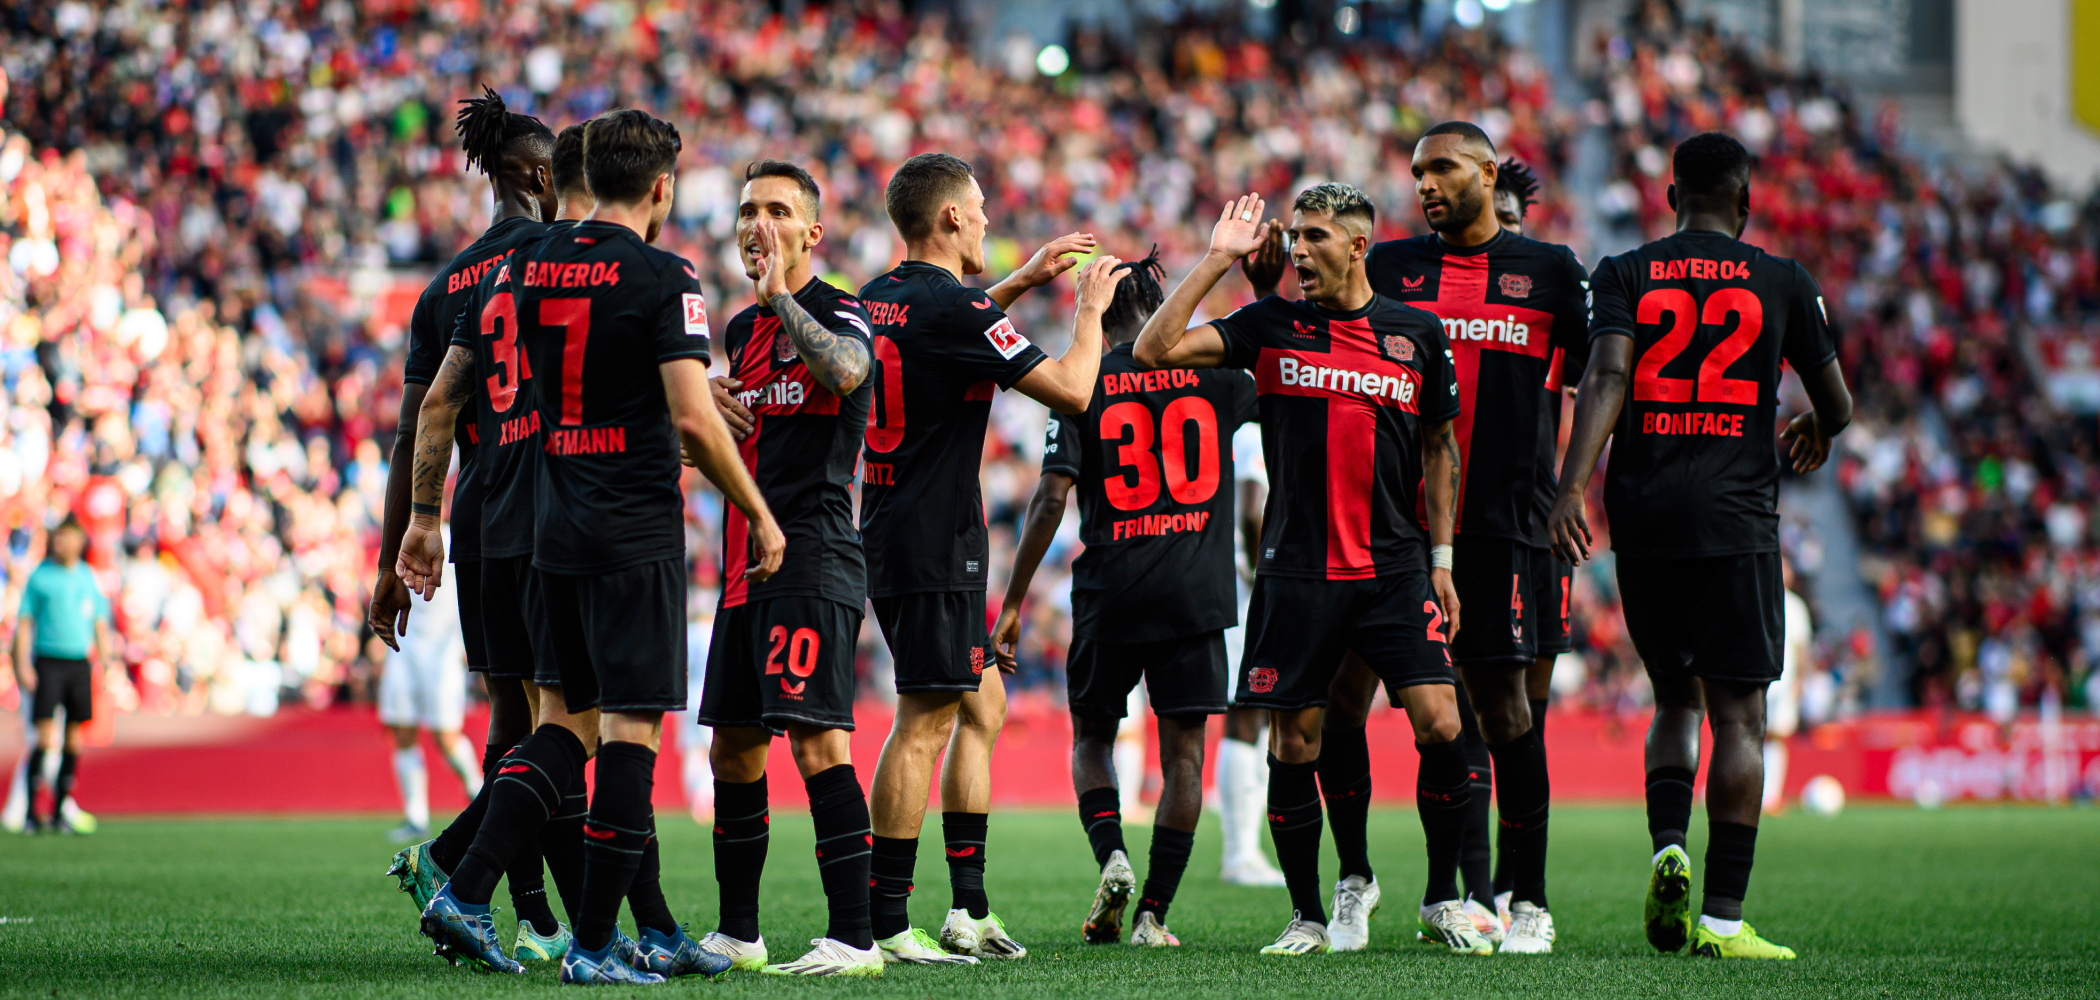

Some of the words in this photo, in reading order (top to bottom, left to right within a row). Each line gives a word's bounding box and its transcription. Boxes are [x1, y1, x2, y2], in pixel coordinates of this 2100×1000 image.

[480, 292, 533, 413] 3
[539, 298, 591, 425] 7
[1634, 288, 1763, 405] 22
[1279, 357, 1415, 403] Barmenia
[1643, 412, 1744, 437] BONIFACE
[1100, 396, 1220, 511] 30
[1423, 600, 1447, 644] 2
[1511, 574, 1524, 619] 4
[765, 625, 820, 678] 20
